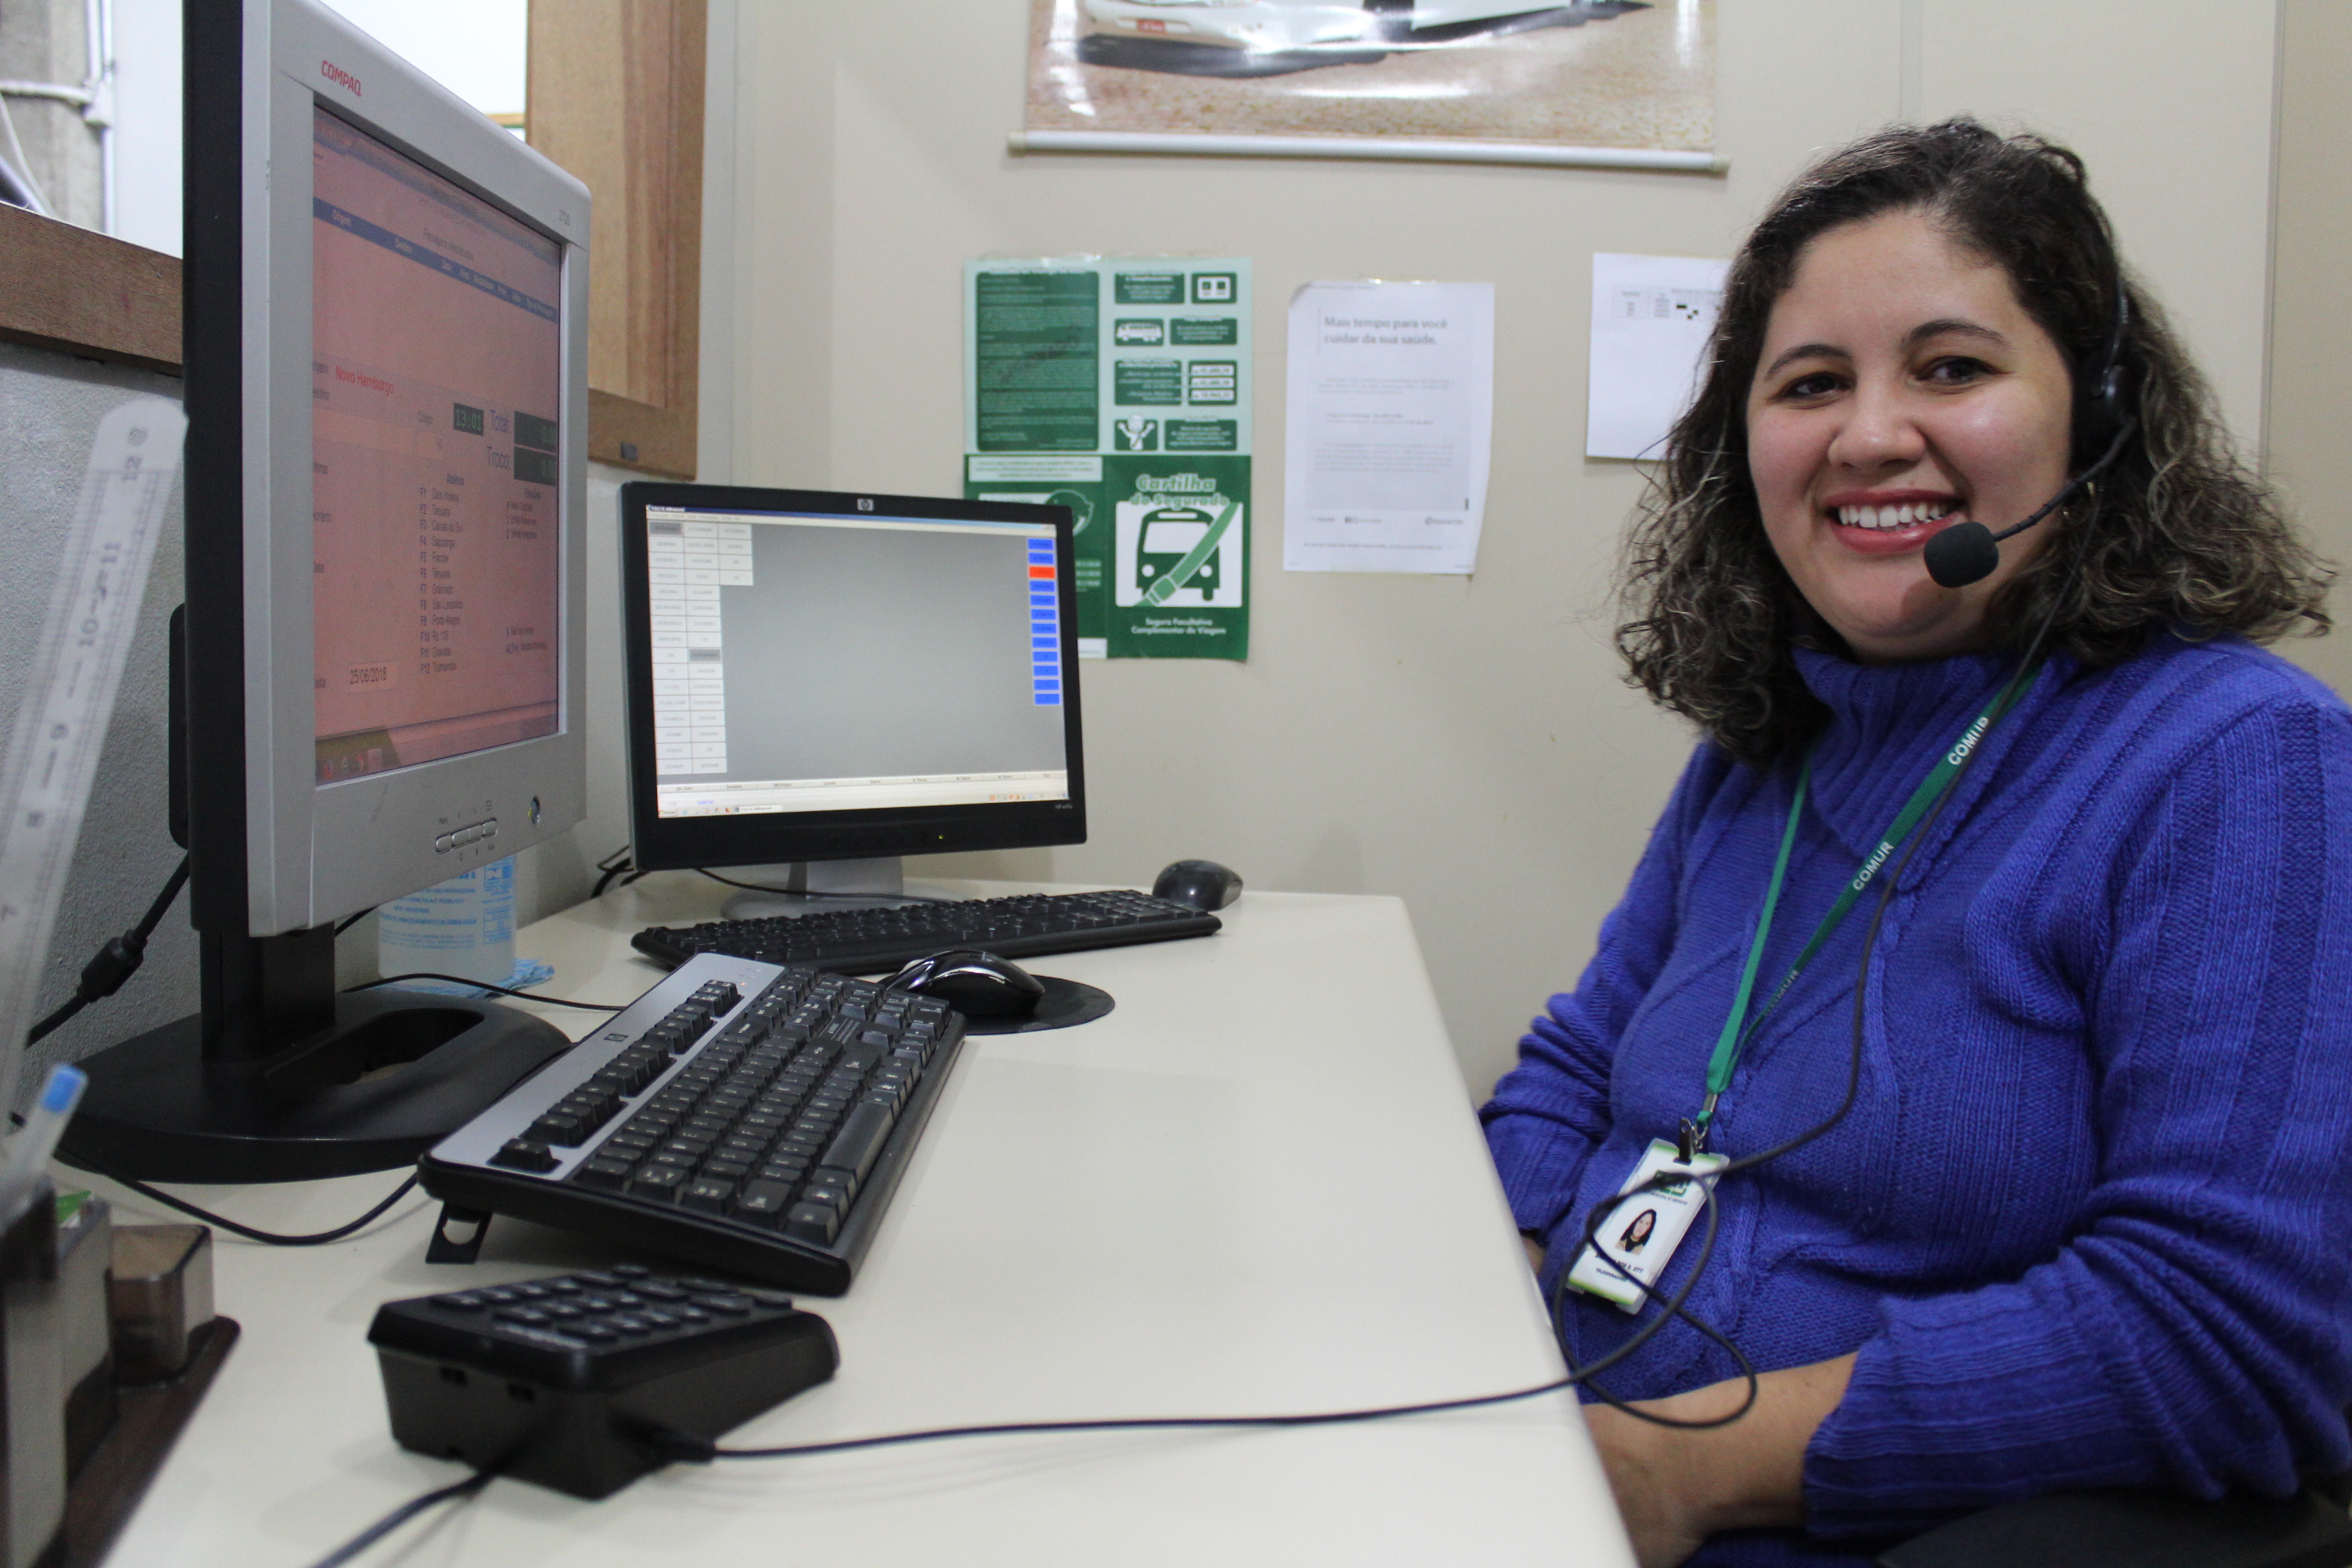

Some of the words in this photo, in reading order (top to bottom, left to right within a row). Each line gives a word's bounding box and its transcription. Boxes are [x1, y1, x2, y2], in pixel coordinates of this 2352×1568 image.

[321, 60, 361, 97] COMPAQ
[1324, 317, 1350, 327] Mais
[1353, 318, 1391, 329] tempo
[1393, 320, 1418, 329] para
[1421, 318, 1448, 328] você
[1324, 332, 1359, 343] cuidar
[1362, 333, 1376, 343] da
[1379, 336, 1399, 344] sua
[336, 365, 355, 384] Novo
[357, 372, 394, 396] Hamburgo
[1136, 473, 1217, 492] Cartilha
[1130, 492, 1151, 505] do
[1154, 492, 1230, 510] Segurado
[1852, 841, 1895, 891] COMUR
